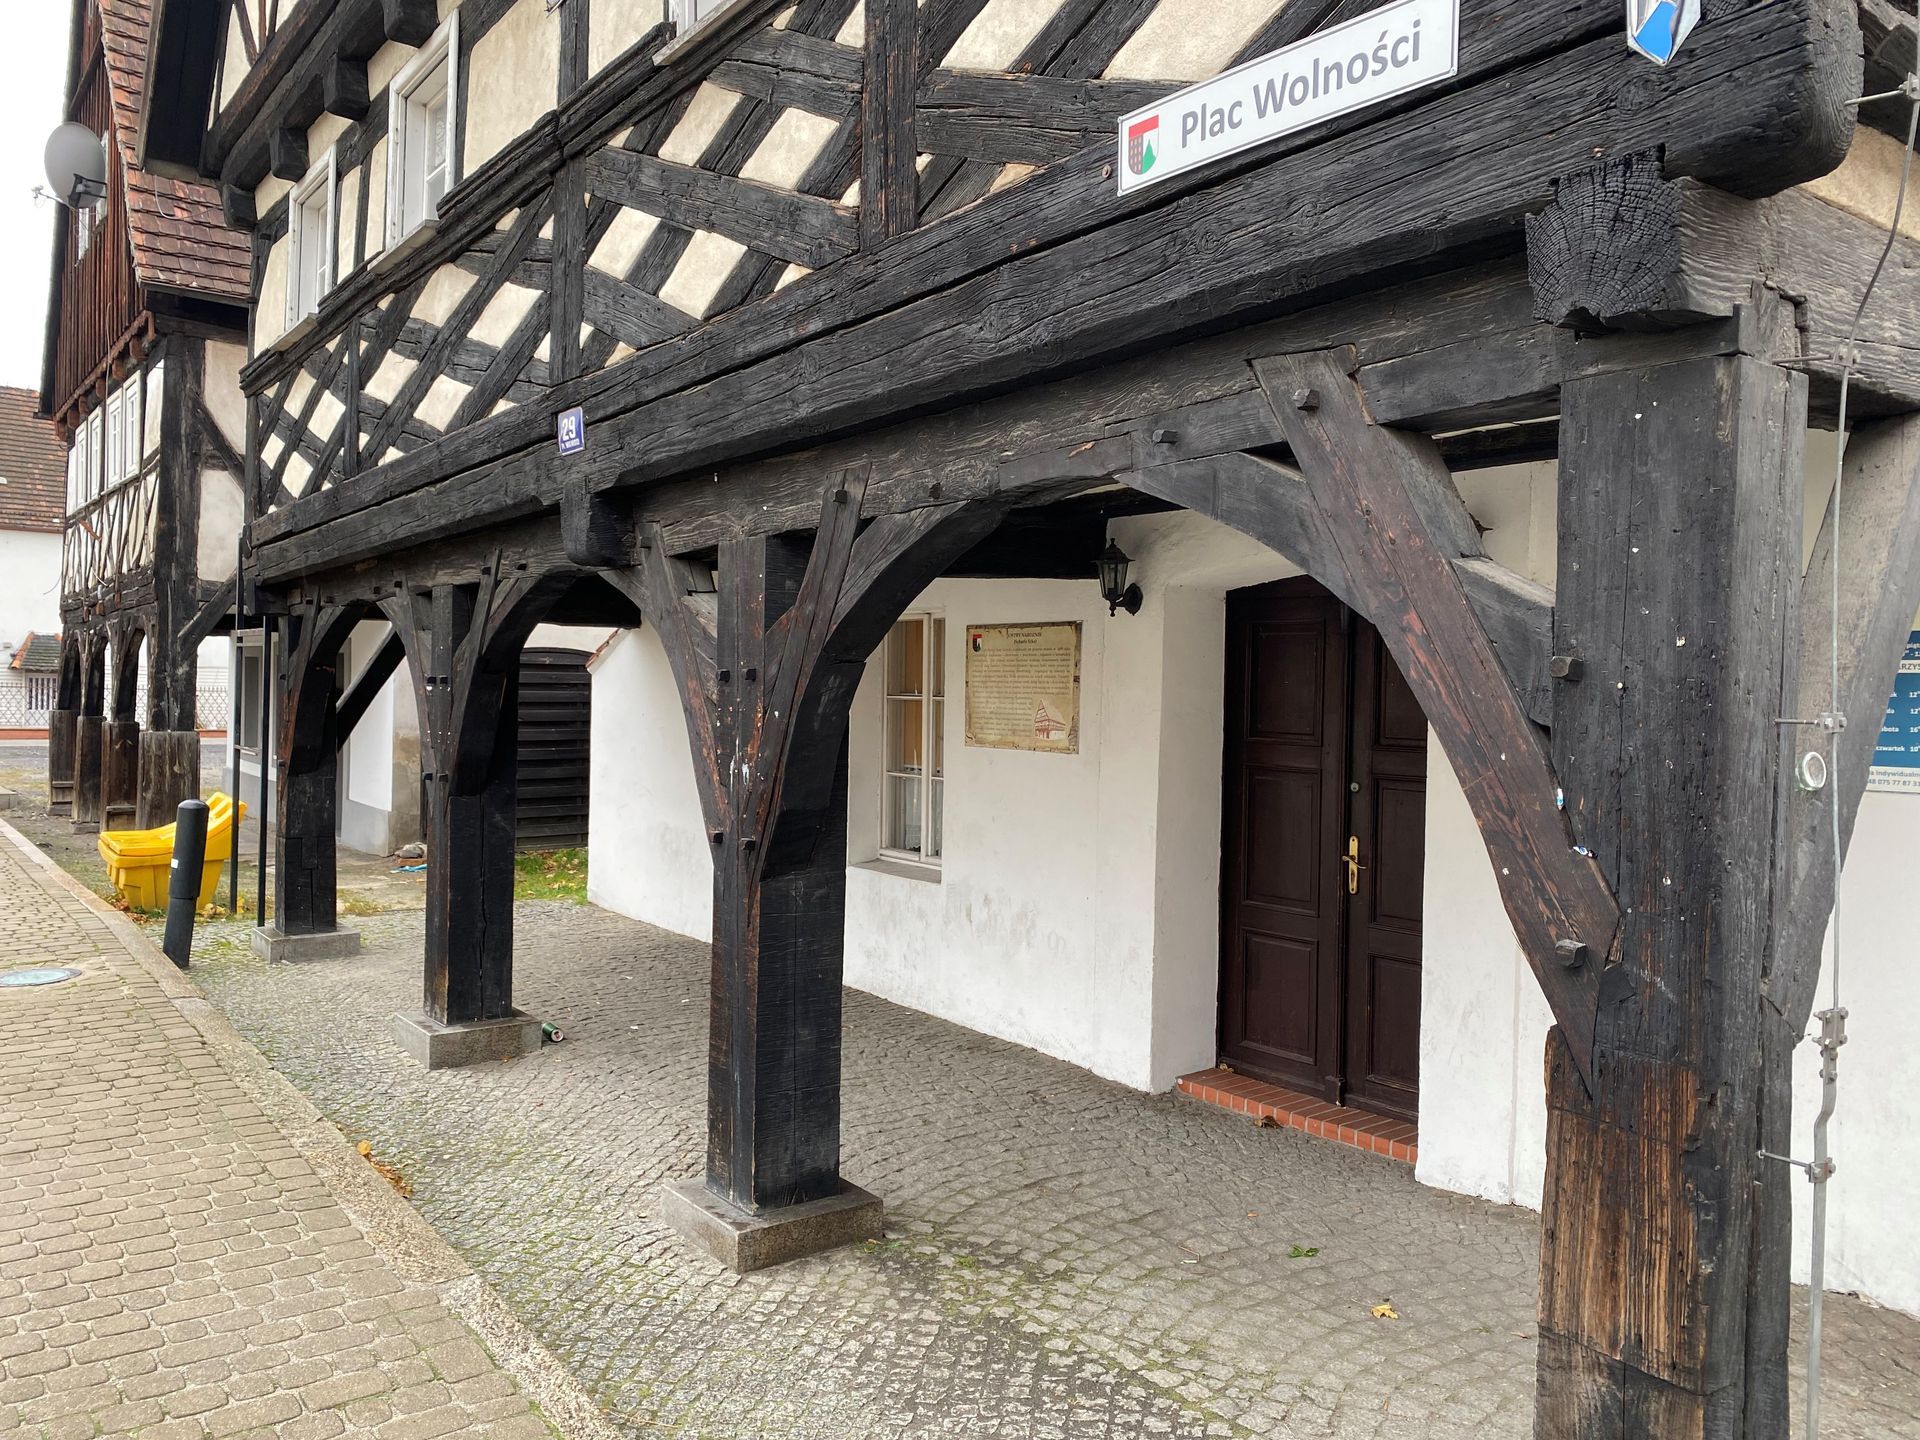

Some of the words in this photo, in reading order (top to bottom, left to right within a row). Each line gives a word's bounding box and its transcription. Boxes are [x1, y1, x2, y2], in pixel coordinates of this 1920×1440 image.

[1181, 100, 1243, 148] Plac
[1253, 19, 1422, 120] Wolności
[562, 416, 576, 441] 29
